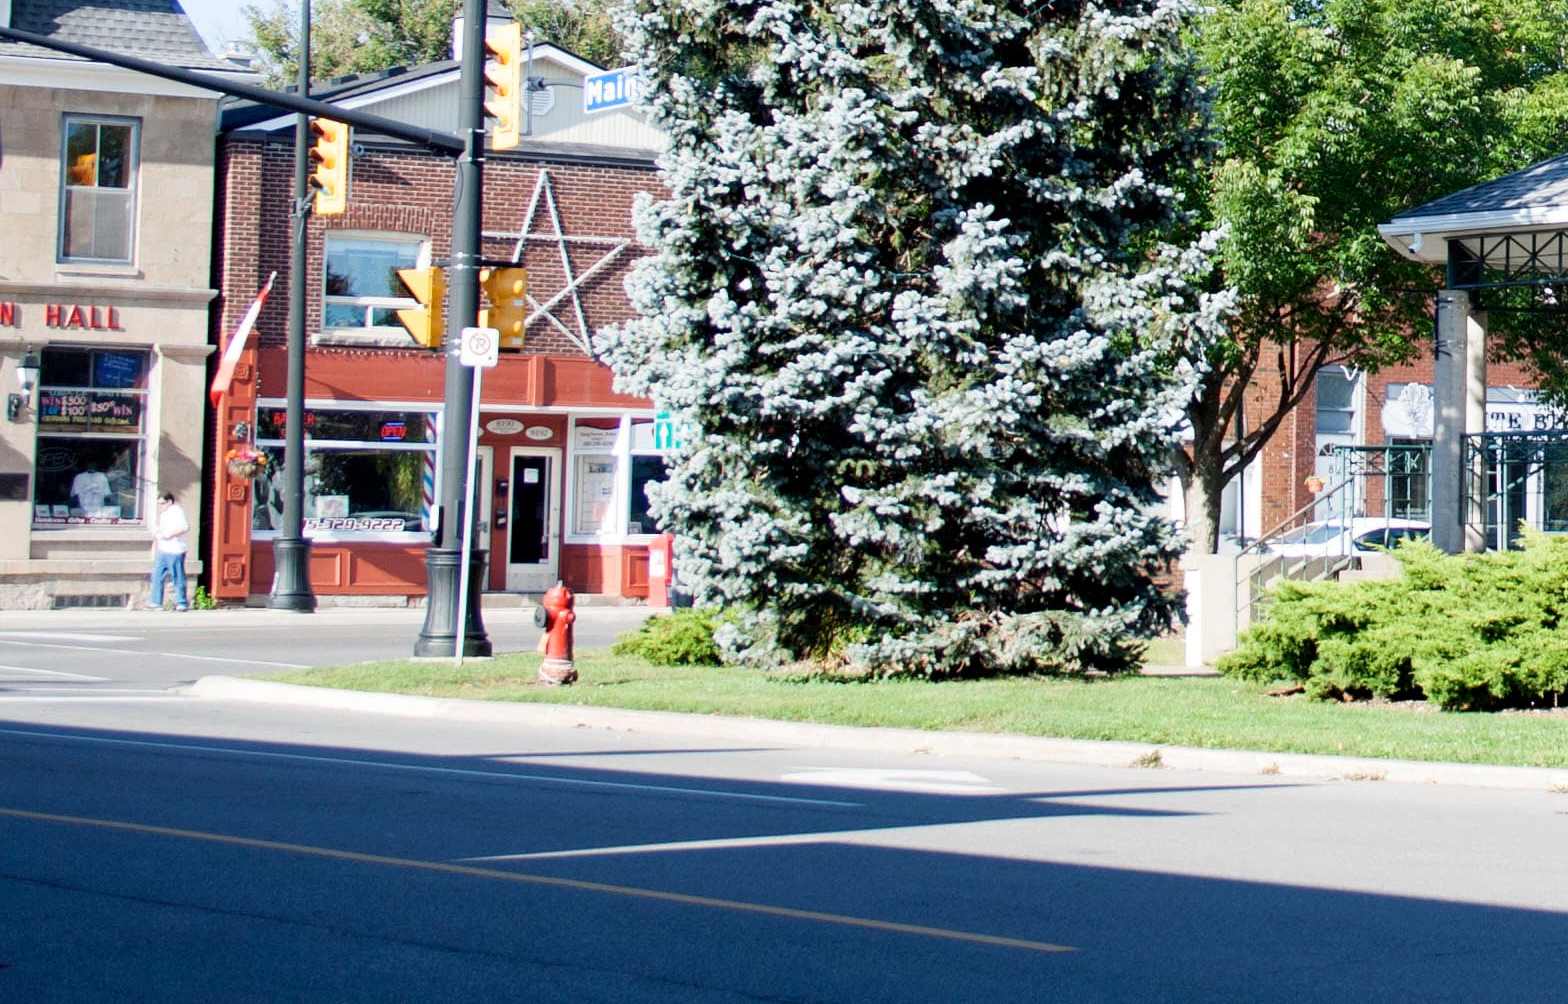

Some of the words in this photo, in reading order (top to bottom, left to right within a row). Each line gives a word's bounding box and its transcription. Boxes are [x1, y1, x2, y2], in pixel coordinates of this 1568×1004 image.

[588, 75, 637, 105] Main
[45, 303, 119, 329] HALL
[381, 426, 406, 437] OPEN
